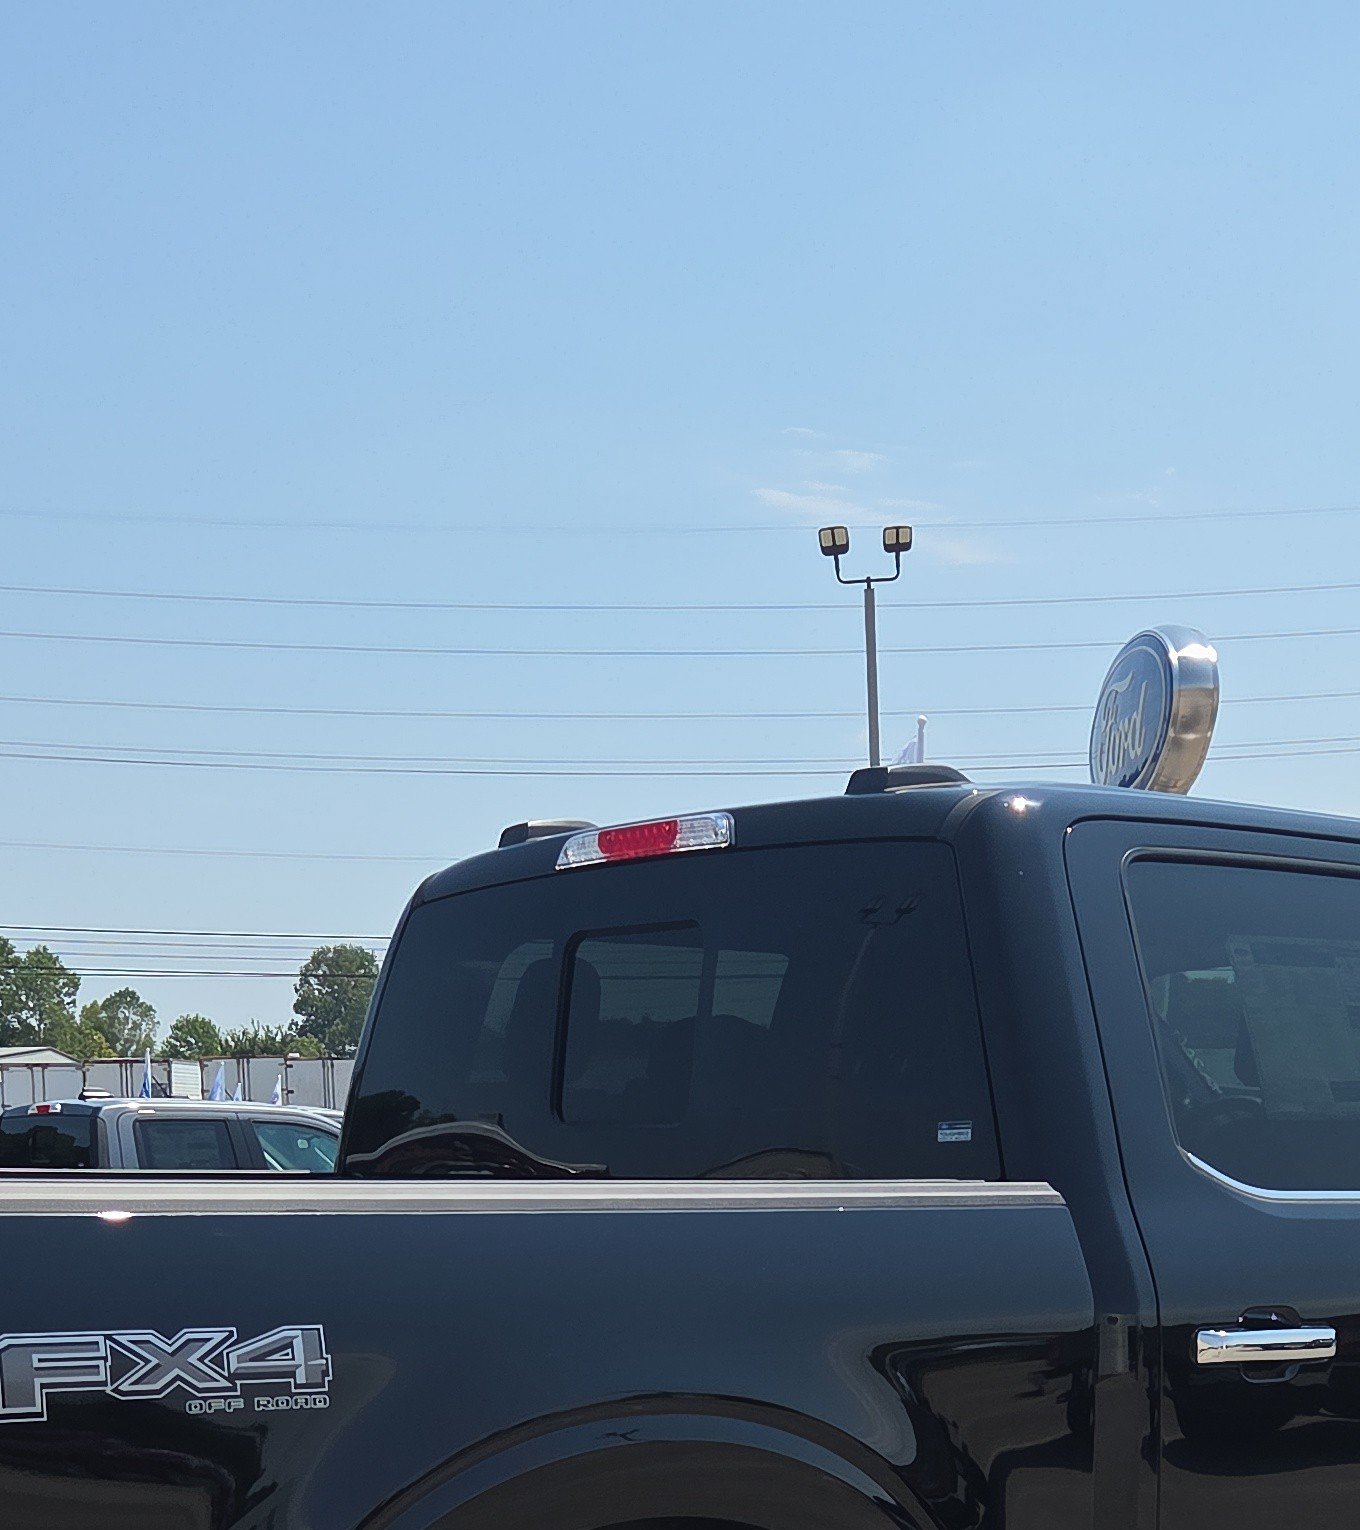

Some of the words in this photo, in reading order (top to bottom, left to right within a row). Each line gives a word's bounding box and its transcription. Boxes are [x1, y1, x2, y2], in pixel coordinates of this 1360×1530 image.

[1097, 670, 1148, 786] Ford
[185, 1397, 246, 1415] OFF
[253, 1394, 331, 1412] ROAD
